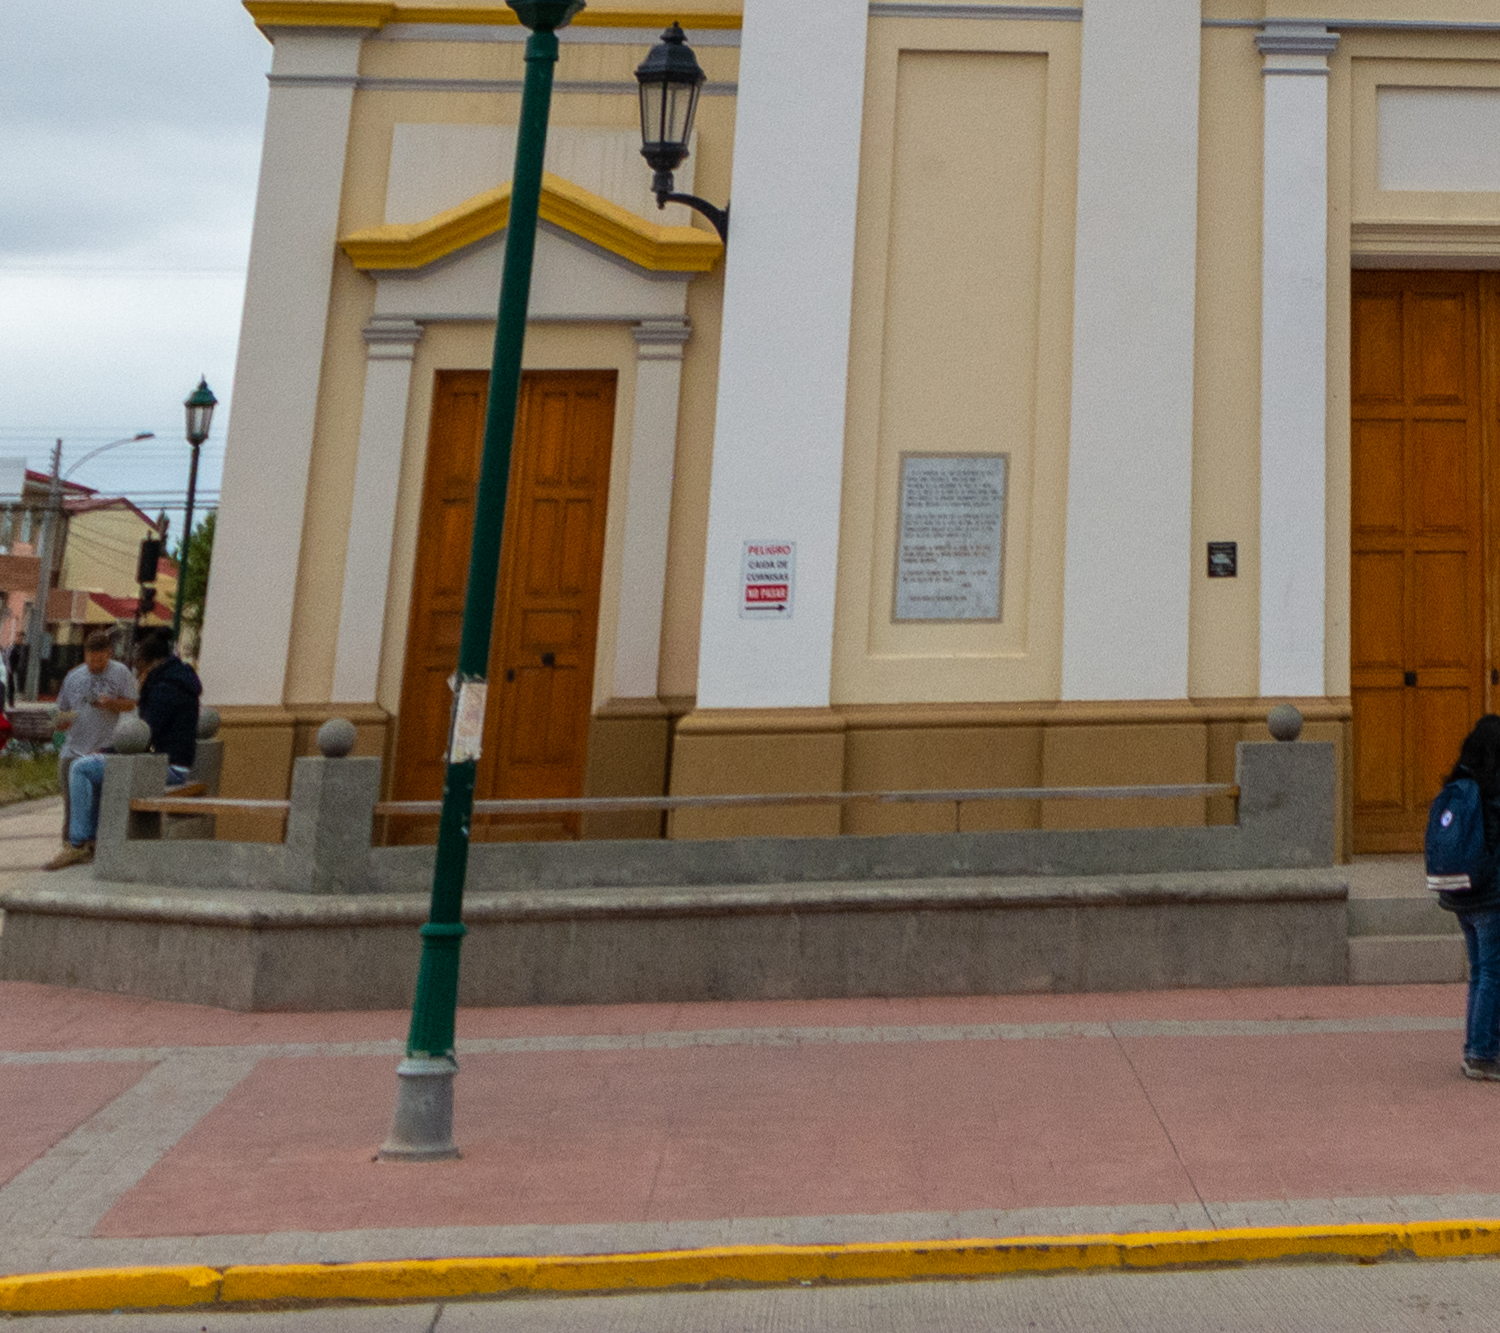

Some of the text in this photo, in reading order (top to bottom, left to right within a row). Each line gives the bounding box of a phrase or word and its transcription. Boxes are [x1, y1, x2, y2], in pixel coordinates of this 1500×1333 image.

[747, 545, 791, 555] PELIGRO
[776, 560, 788, 568] DE
[748, 587, 787, 599] NO PASAR
